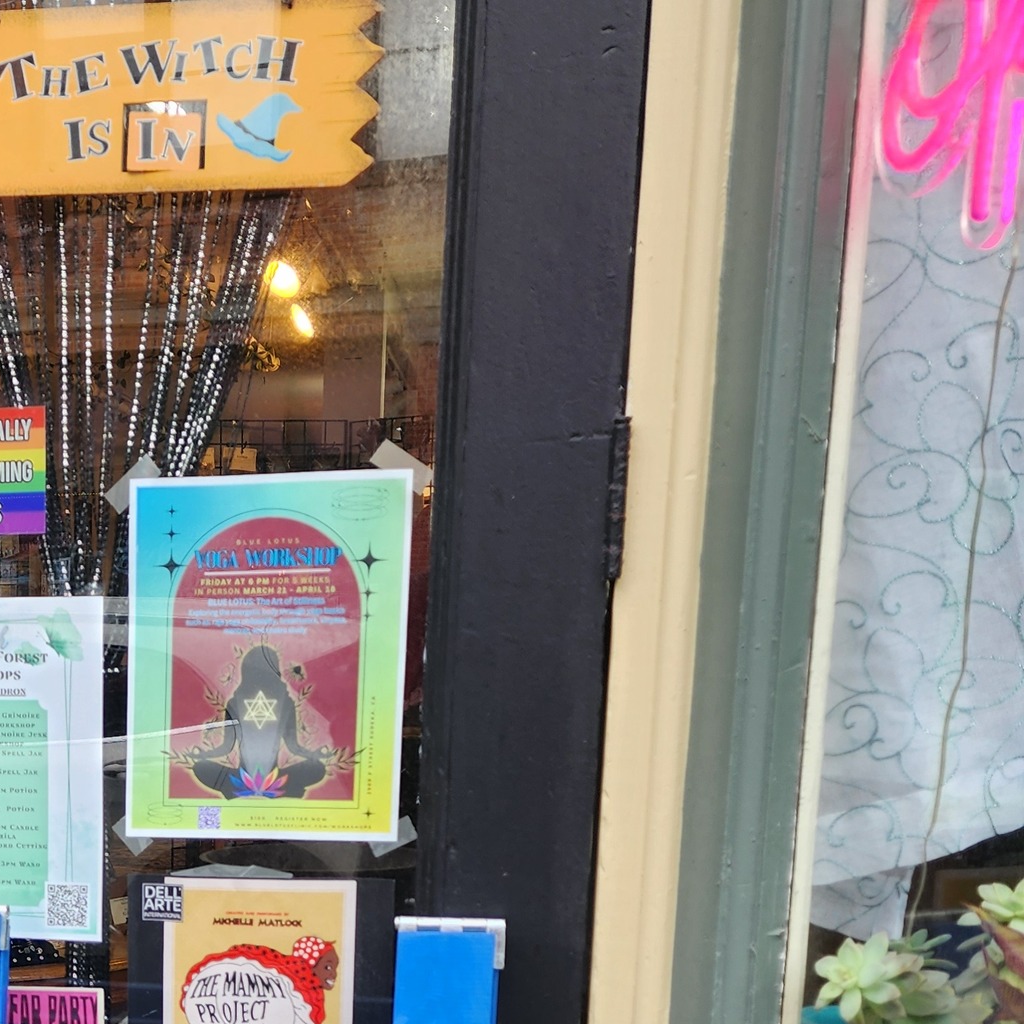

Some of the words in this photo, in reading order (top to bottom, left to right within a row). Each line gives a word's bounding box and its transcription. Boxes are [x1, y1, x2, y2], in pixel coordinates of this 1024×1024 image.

[119, 34, 303, 86] WITCH
[63, 117, 111, 161] IS
[135, 118, 196, 161] IN
[268, 537, 300, 545] LOTUS
[194, 550, 239, 569] YOGA
[245, 546, 343, 568] WORKSHOP
[201, 578, 231, 586] FRIDAY
[234, 578, 245, 586] AT
[256, 577, 270, 585] PM
[272, 577, 289, 585] FOR
[300, 576, 330, 584] WEEKS
[194, 588, 204, 596] IN
[206, 587, 240, 596] PERSON
[243, 587, 274, 595] MARCH
[296, 586, 322, 594] APRIL
[145, 886, 182, 900] DELL'
[144, 898, 182, 912] ARTE
[190, 973, 221, 999] THE
[222, 970, 286, 999] MAMMY
[195, 999, 270, 1024] PROJECT
